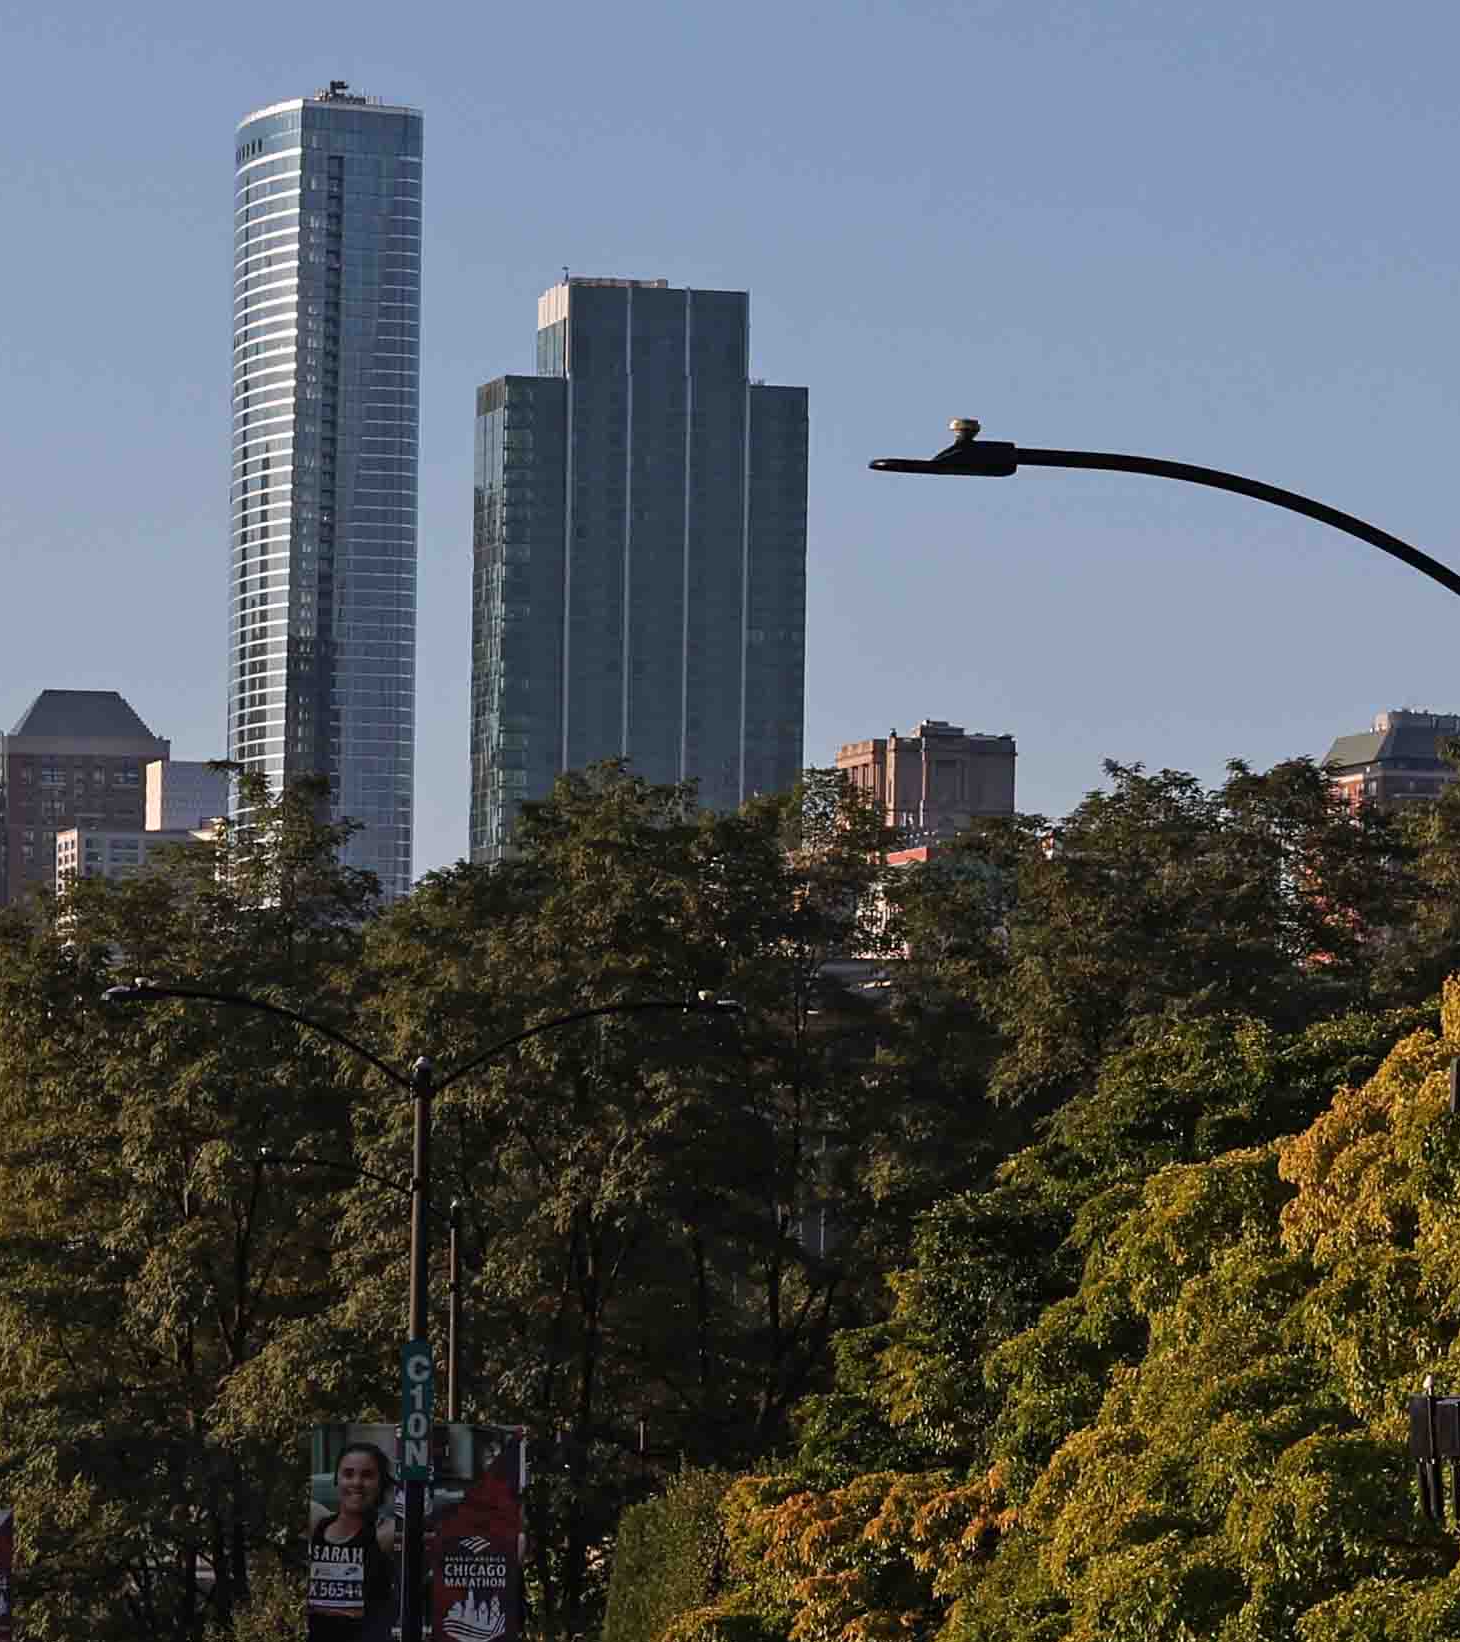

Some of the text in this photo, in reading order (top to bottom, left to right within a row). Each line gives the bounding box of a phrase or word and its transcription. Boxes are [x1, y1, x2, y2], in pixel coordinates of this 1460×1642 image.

[405, 1354, 431, 1466] C10N
[312, 1546, 362, 1563] SARAH
[444, 1563, 507, 1577] CHICAGO
[444, 1578, 506, 1589] MARATHON
